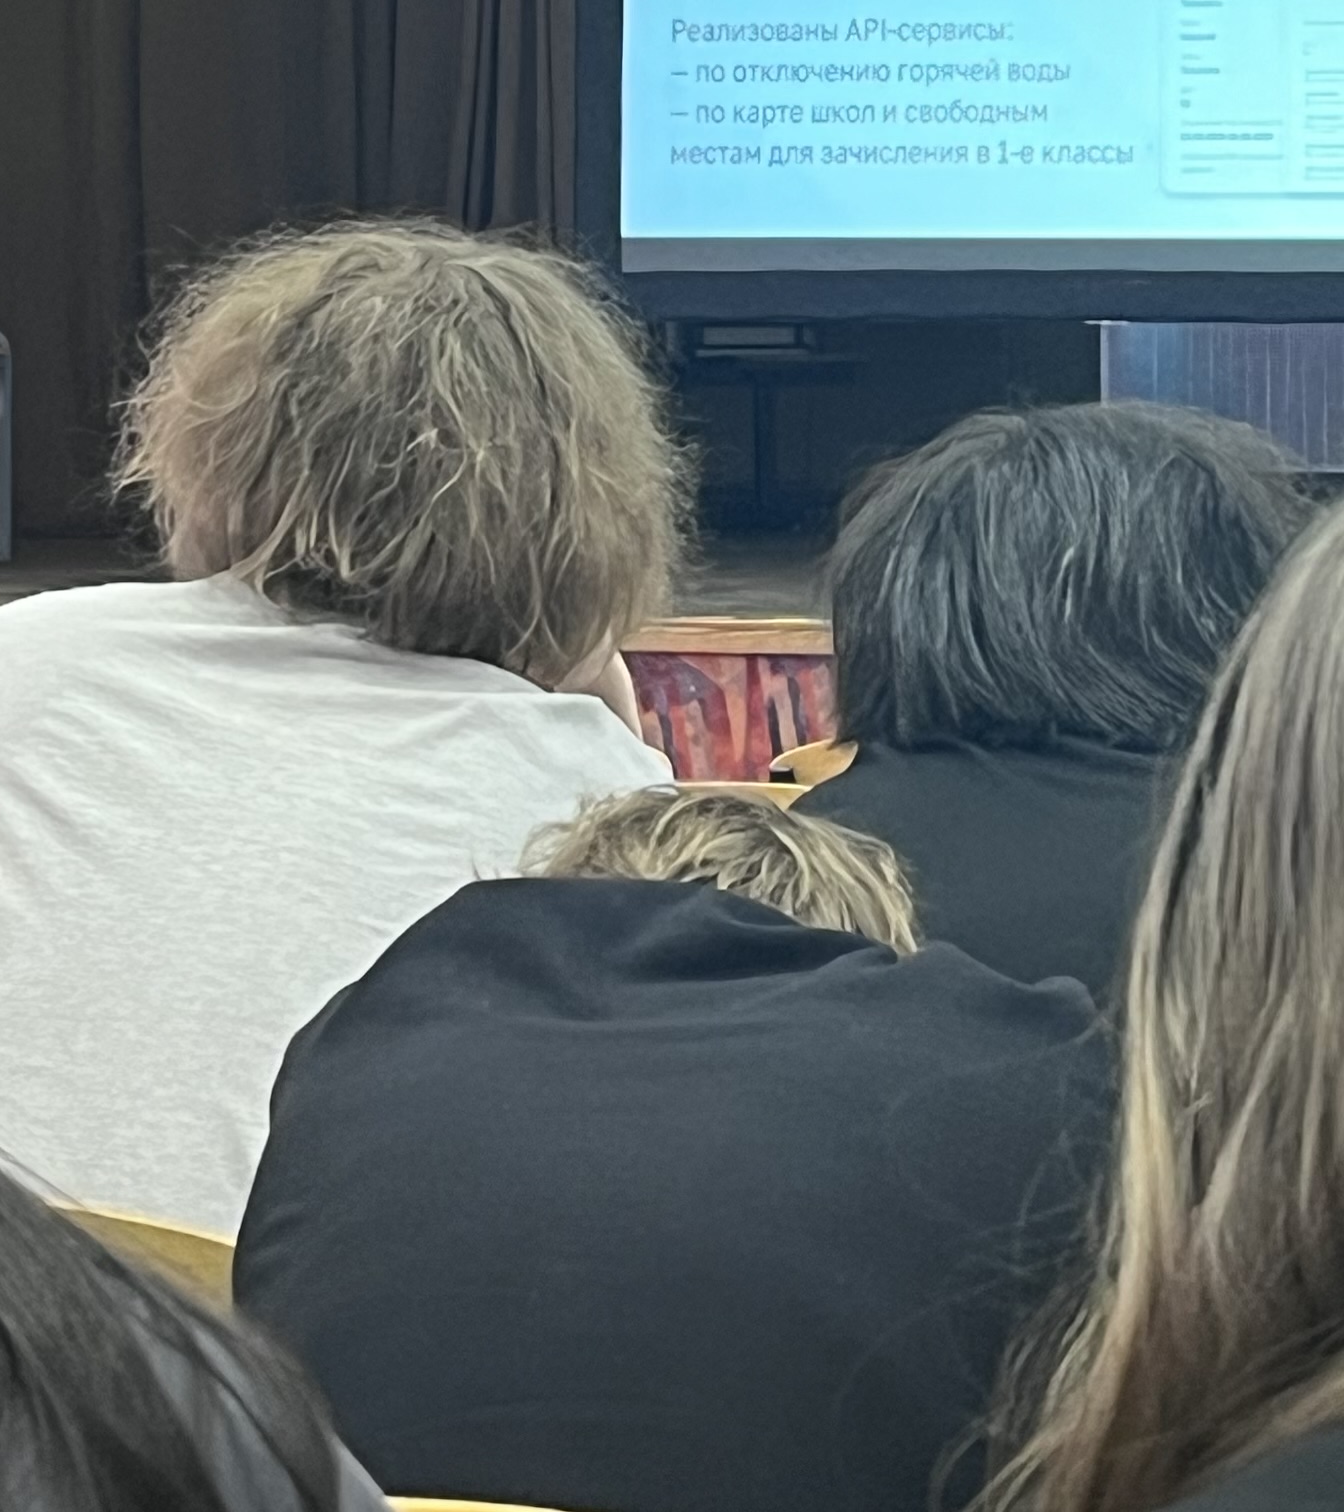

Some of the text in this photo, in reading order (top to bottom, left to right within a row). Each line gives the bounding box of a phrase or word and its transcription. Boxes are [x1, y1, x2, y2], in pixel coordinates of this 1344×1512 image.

[671, 17, 838, 44] Реализованы
[695, 63, 726, 83] по
[732, 63, 891, 83] отключению
[897, 57, 1000, 88] горячей
[1007, 62, 1072, 84] воды
[695, 104, 726, 124] по
[732, 104, 804, 130] карте
[811, 104, 876, 124] школ
[882, 104, 897, 124] и
[904, 98, 1048, 125] свободным
[670, 139, 1134, 168] местам для зачисления в 1-е классы
